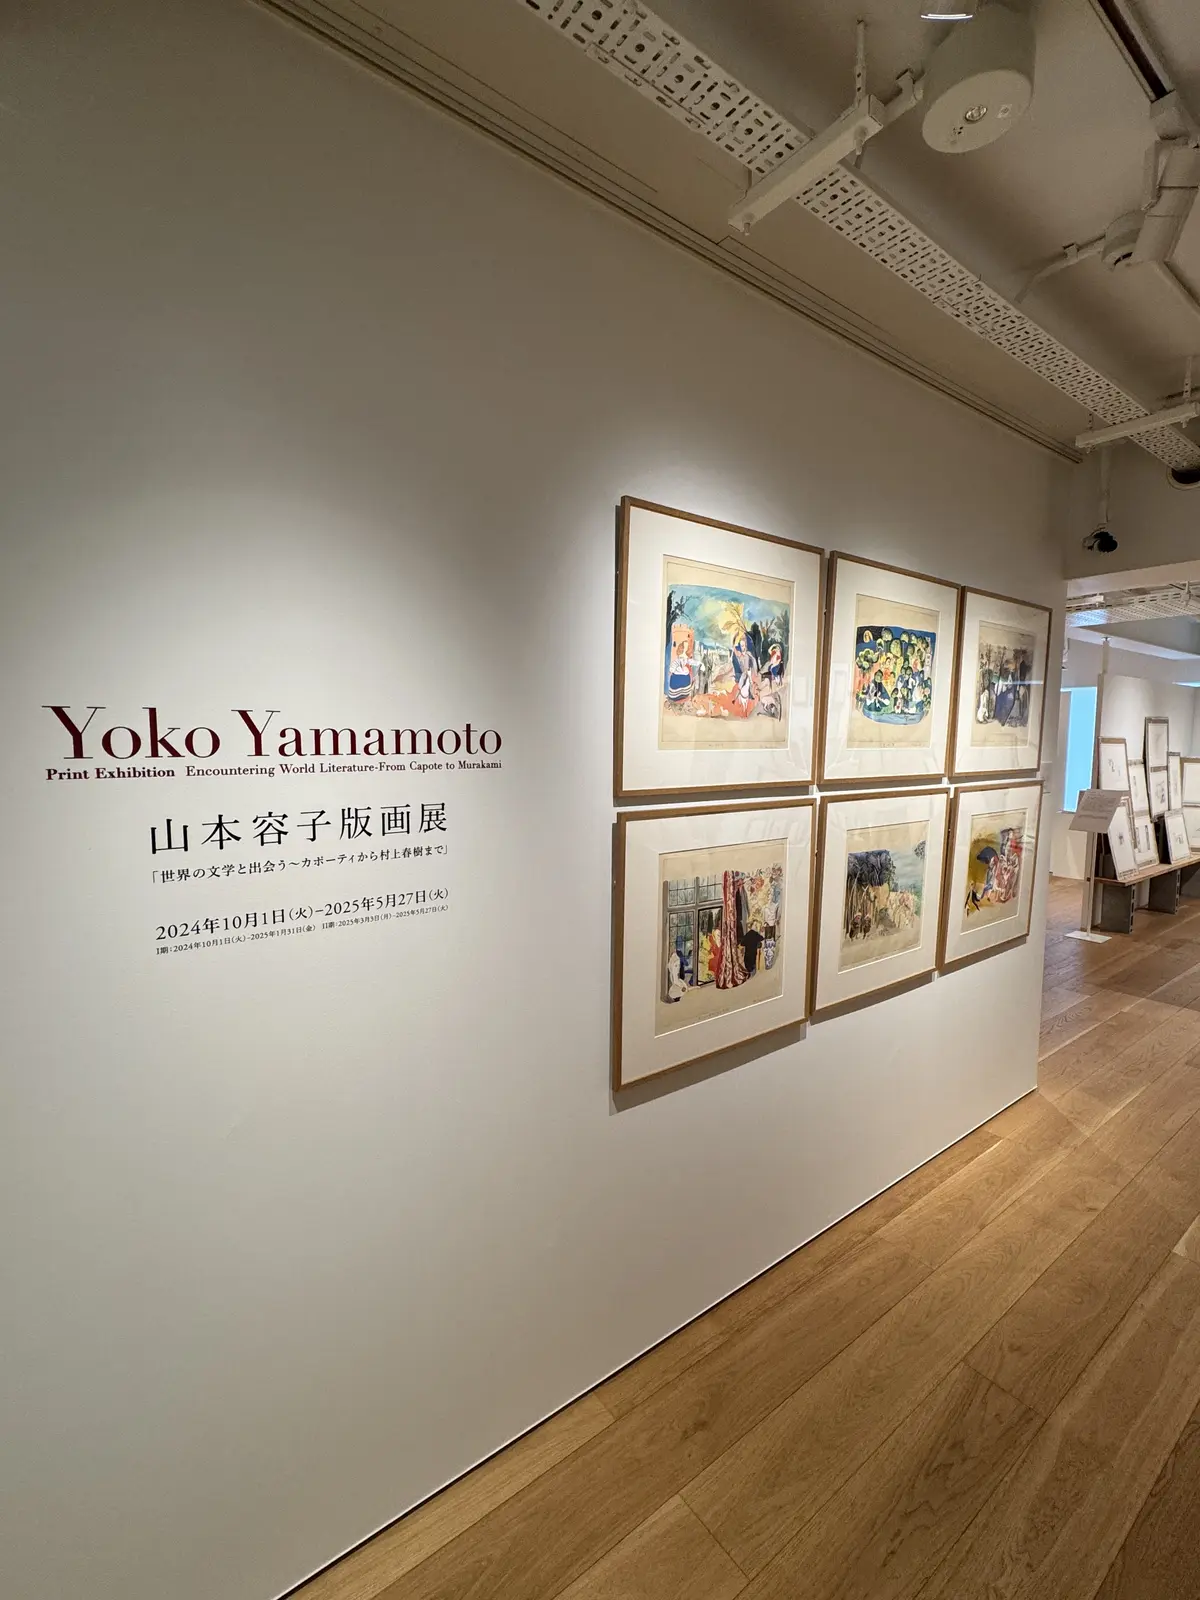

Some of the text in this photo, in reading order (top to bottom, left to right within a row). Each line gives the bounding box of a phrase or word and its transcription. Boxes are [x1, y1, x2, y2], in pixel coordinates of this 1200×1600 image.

[41, 705, 503, 760] Yoko Yamamoto
[46, 768, 90, 780] Print
[94, 767, 176, 779] Exhibition
[185, 764, 276, 777] Encountering
[279, 763, 316, 774] World
[409, 761, 443, 773] Capote
[445, 761, 456, 770] to
[458, 760, 502, 769] Murakami
[150, 802, 448, 855] 山本容子版画展
